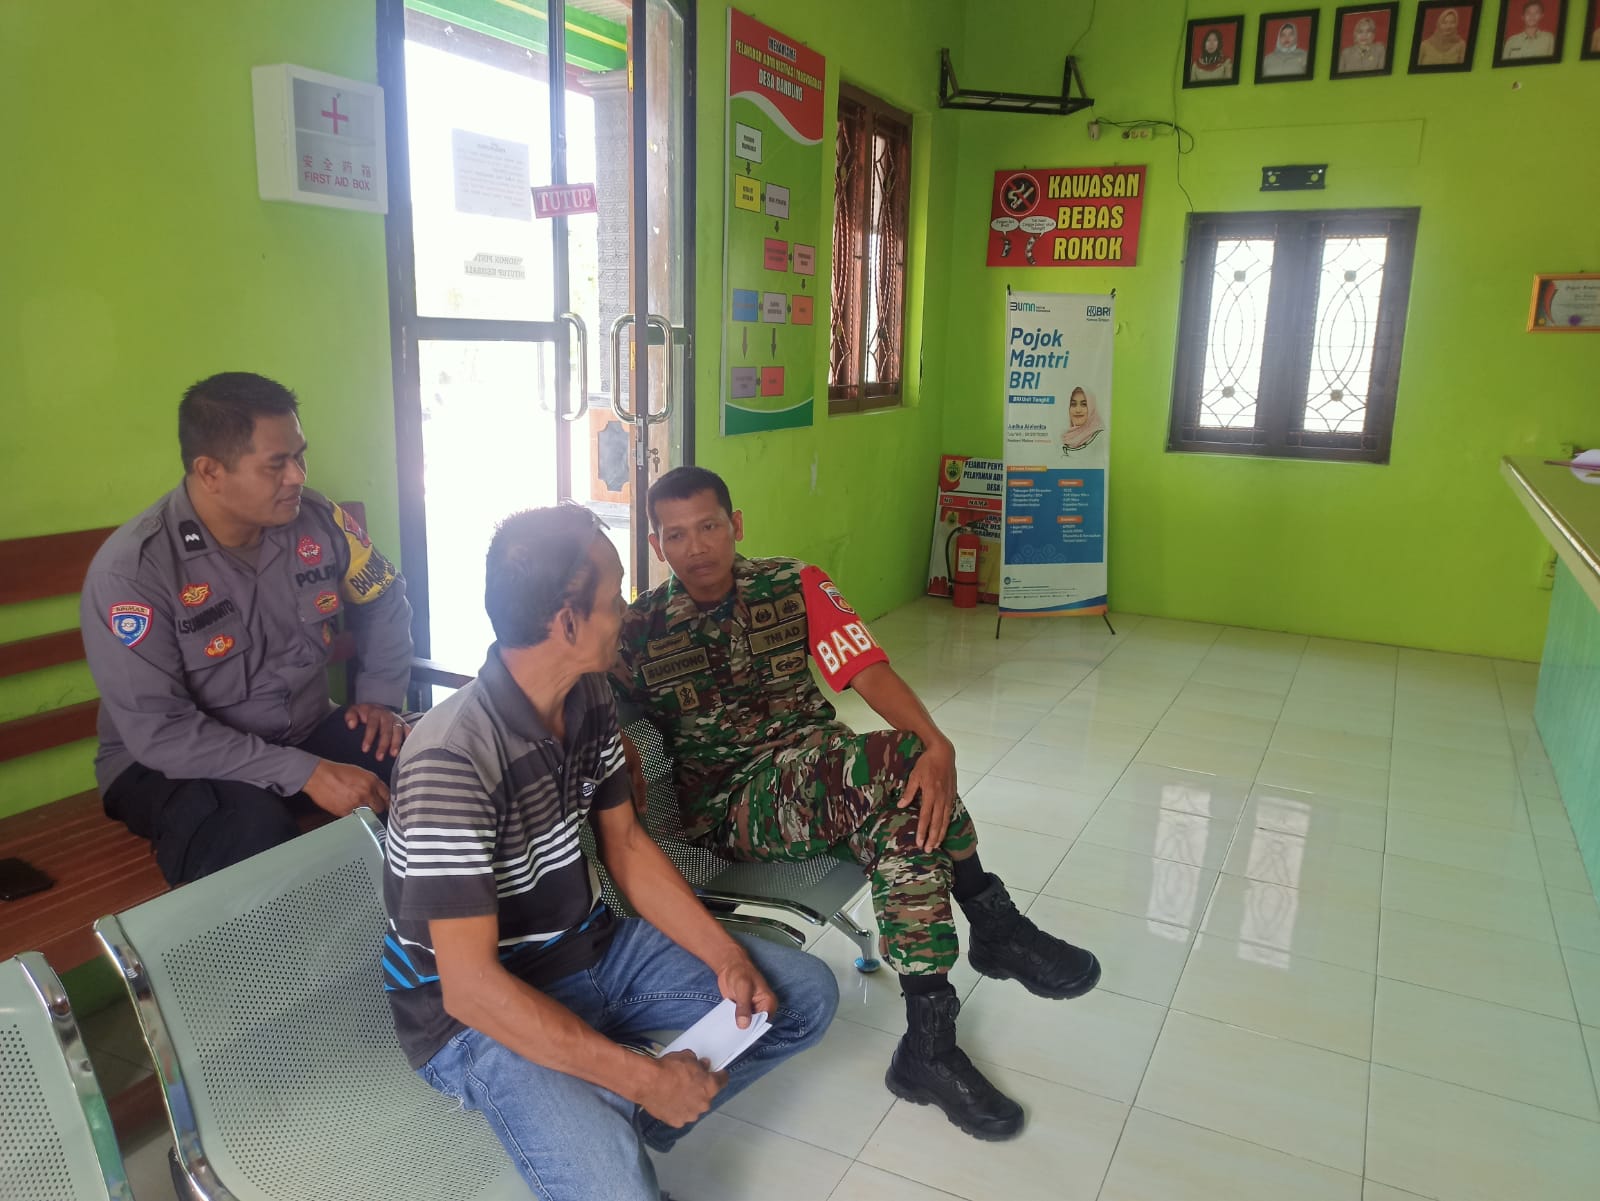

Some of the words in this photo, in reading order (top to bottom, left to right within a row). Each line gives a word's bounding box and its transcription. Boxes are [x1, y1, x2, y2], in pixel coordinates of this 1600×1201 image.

[758, 69, 775, 89] DESA
[304, 171, 331, 185] FIRST
[335, 175, 349, 187] AID
[352, 179, 371, 192] BOX
[1048, 173, 1140, 199] KAWASAN
[538, 188, 593, 213] TUTUP
[1057, 205, 1124, 230] BEBAS
[1053, 237, 1123, 260] ROKOK
[1010, 327, 1064, 351] Pojok
[1009, 349, 1070, 369] Mantri
[1009, 371, 1041, 389] BRI
[963, 470, 993, 481] PELAYANAN
[987, 483, 1000, 492] DESA
[764, 630, 784, 646] TNI
[784, 626, 800, 639] AD
